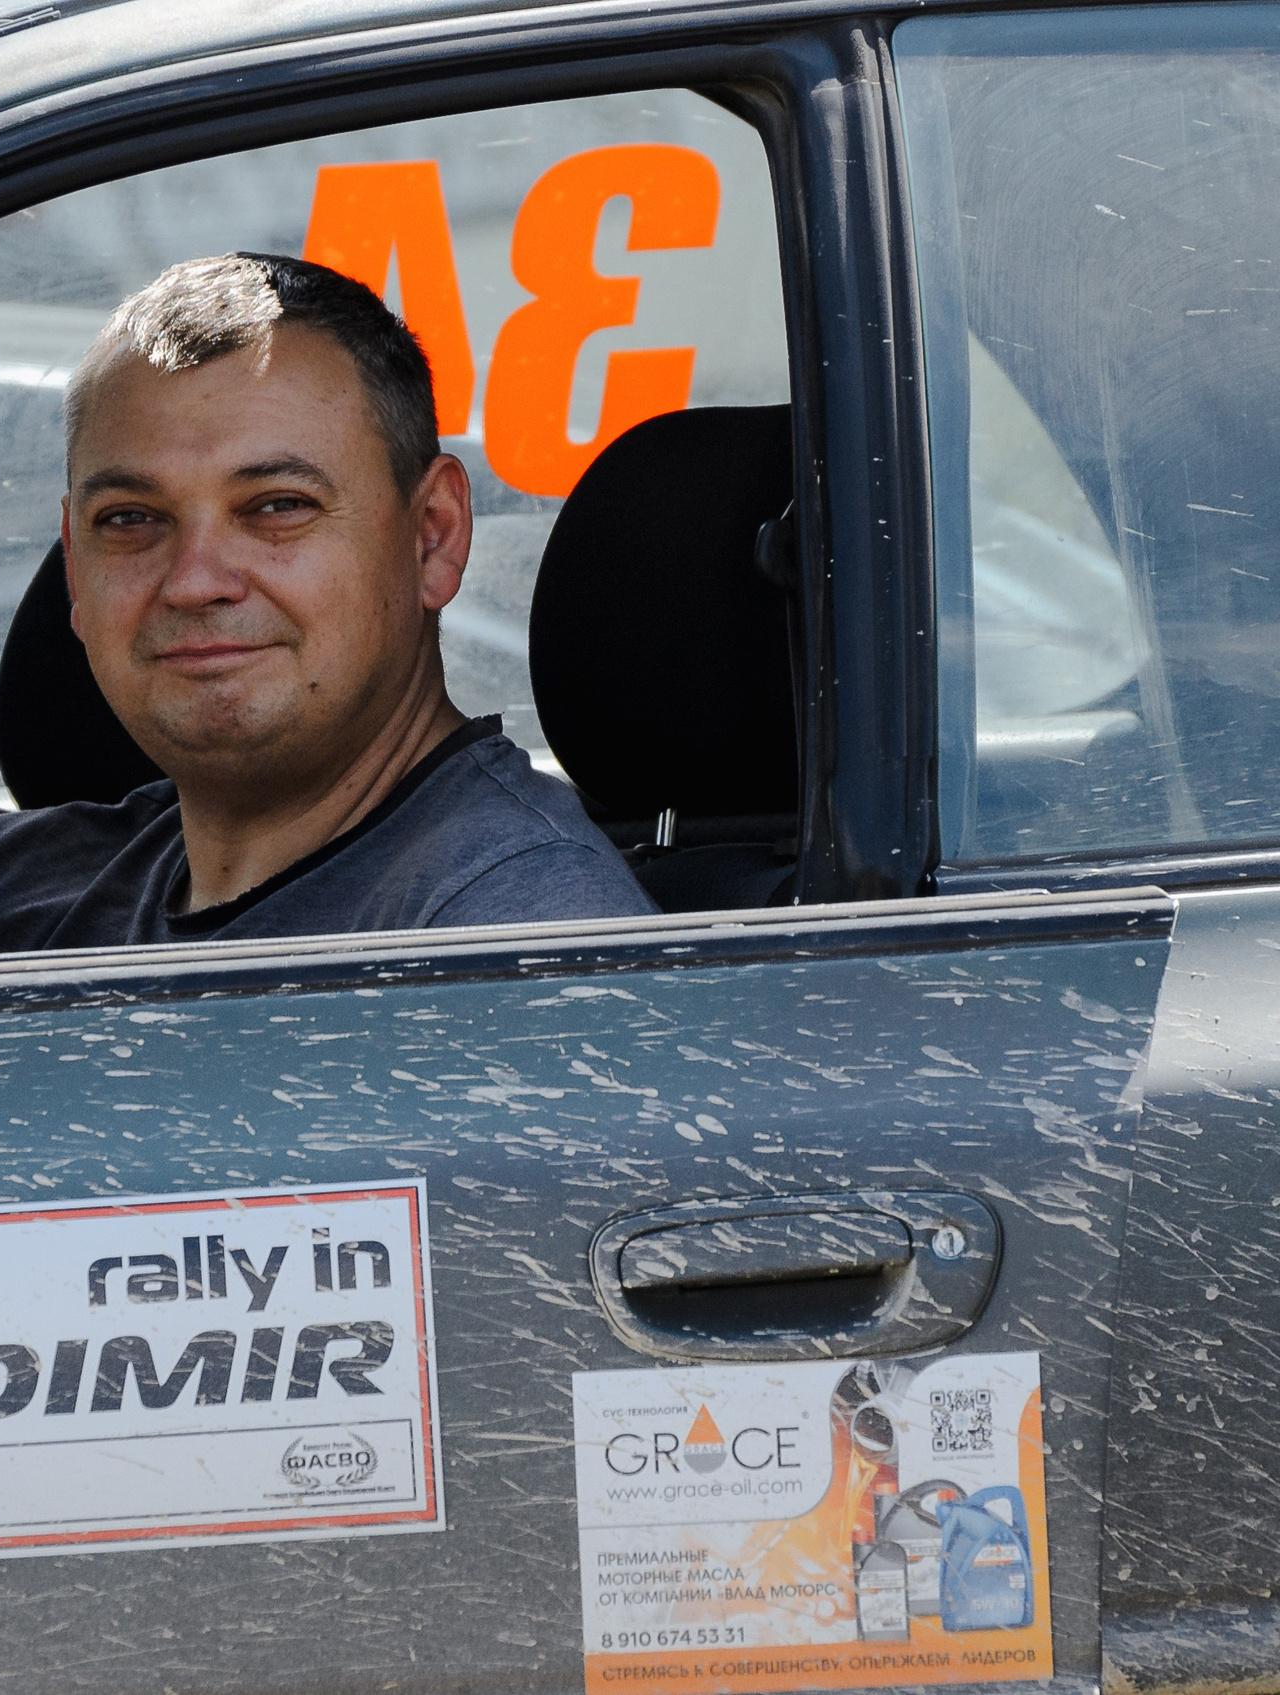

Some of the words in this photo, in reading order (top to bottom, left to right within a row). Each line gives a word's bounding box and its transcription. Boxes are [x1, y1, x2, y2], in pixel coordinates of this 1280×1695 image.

[87, 1234, 289, 1313] rally
[314, 1226, 392, 1293] in
[606, 1479, 803, 1503] www.grace-oil.com
[597, 1549, 709, 1567] ПРЕМИАЛЬНЫЕ
[598, 1571, 682, 1586] МОТОРНЫЕ
[687, 1567, 745, 1583] МАСЛА
[599, 1593, 620, 1606] ОТ
[624, 1588, 712, 1605] КОМПАНИИ
[601, 1633, 613, 1649] 8
[618, 1631, 651, 1648] 910
[658, 1629, 692, 1645] 674
[697, 1628, 720, 1644] 53
[724, 1627, 745, 1643] 31
[602, 1663, 690, 1683] СТРЕМЯСЬ
